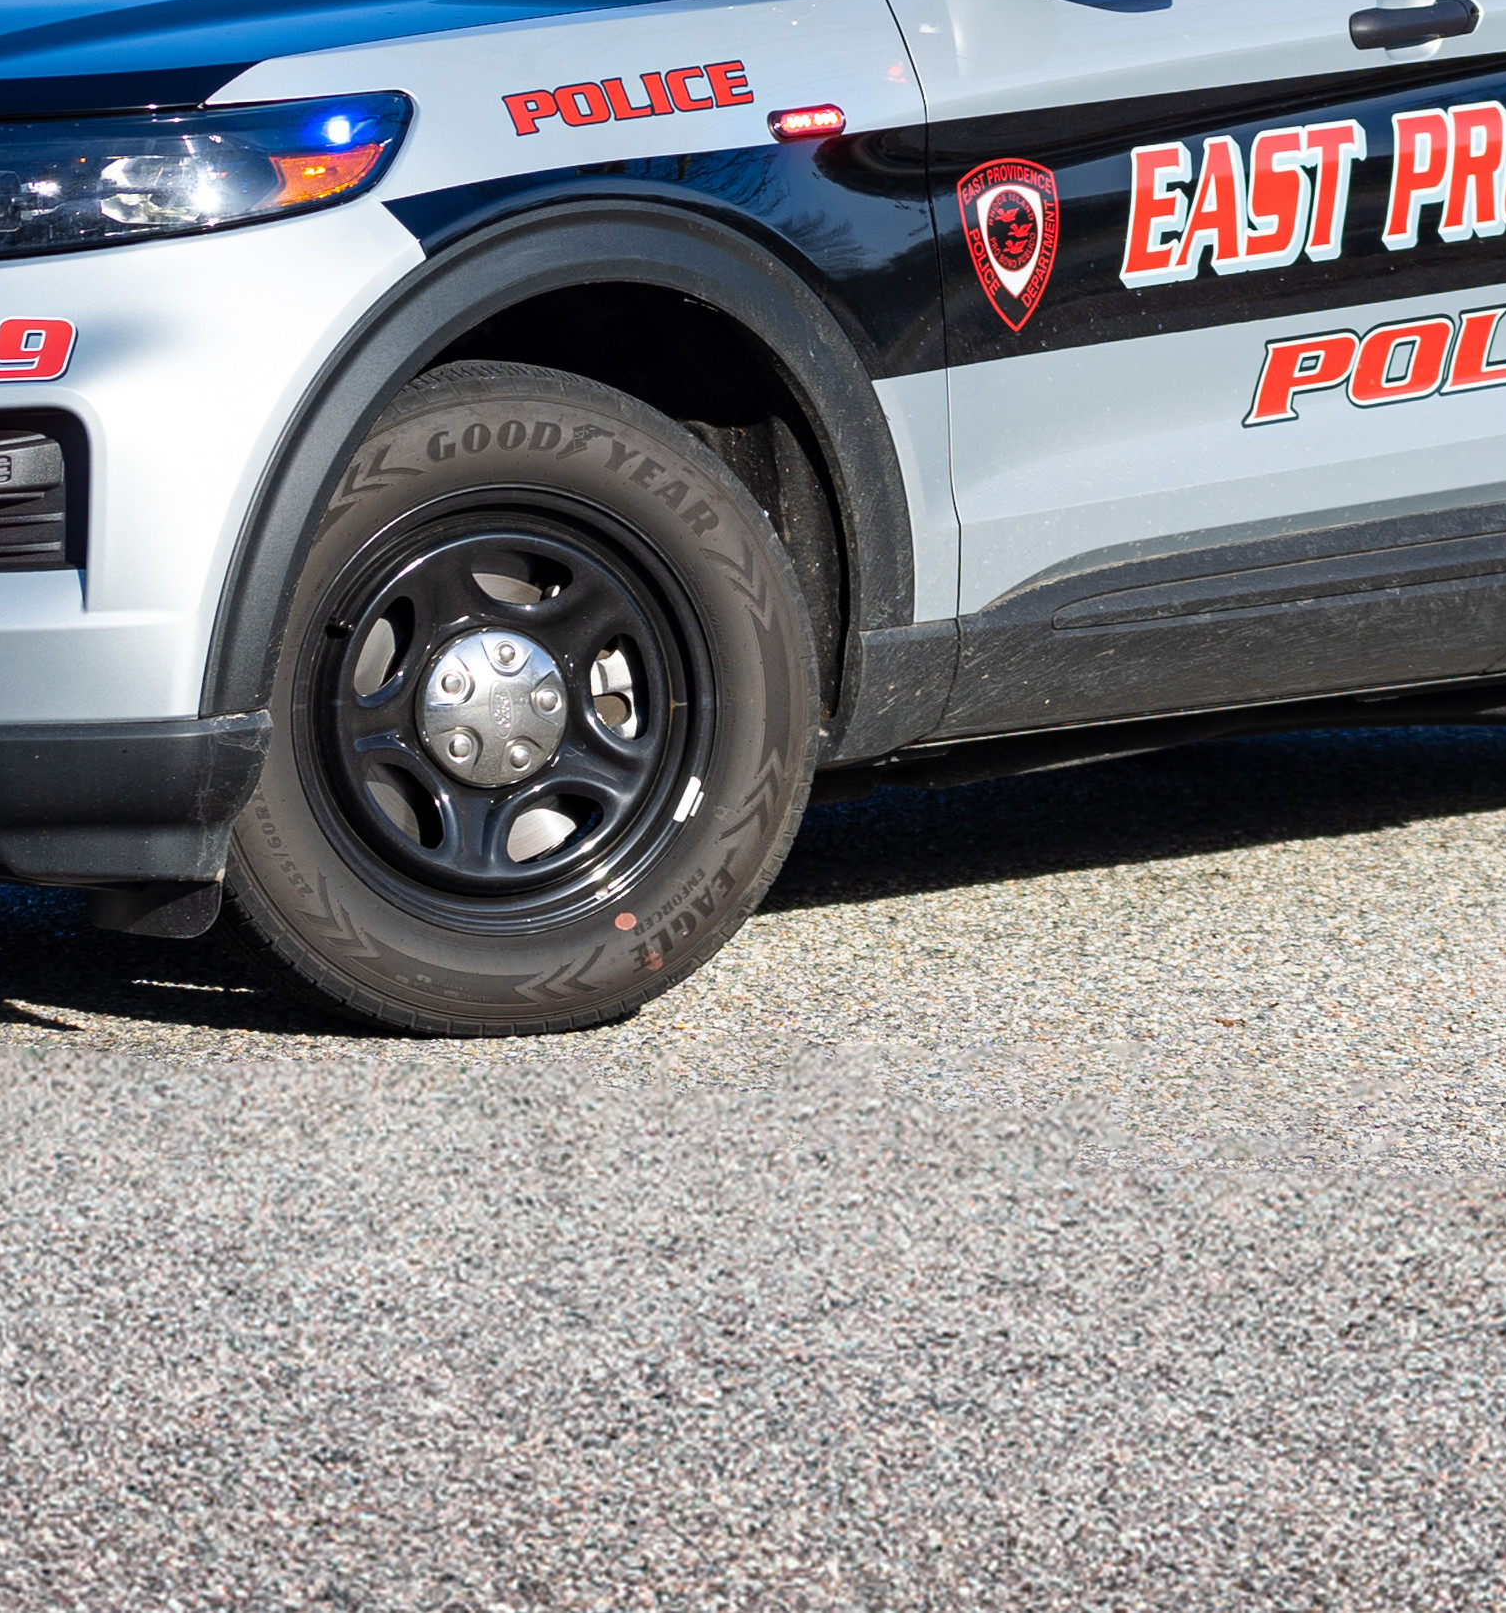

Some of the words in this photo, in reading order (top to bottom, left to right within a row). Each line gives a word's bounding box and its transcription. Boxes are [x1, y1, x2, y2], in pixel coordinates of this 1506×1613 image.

[501, 60, 754, 136] POLICE
[961, 173, 988, 205] EAST
[987, 165, 1053, 194] PROVIDENCE
[1119, 119, 1368, 289] EAST
[969, 228, 1001, 295] POLICE
[1021, 199, 1056, 308] DEPARTMENT
[252, 790, 314, 898] 255/60R1
[630, 866, 736, 974] EAGLE
